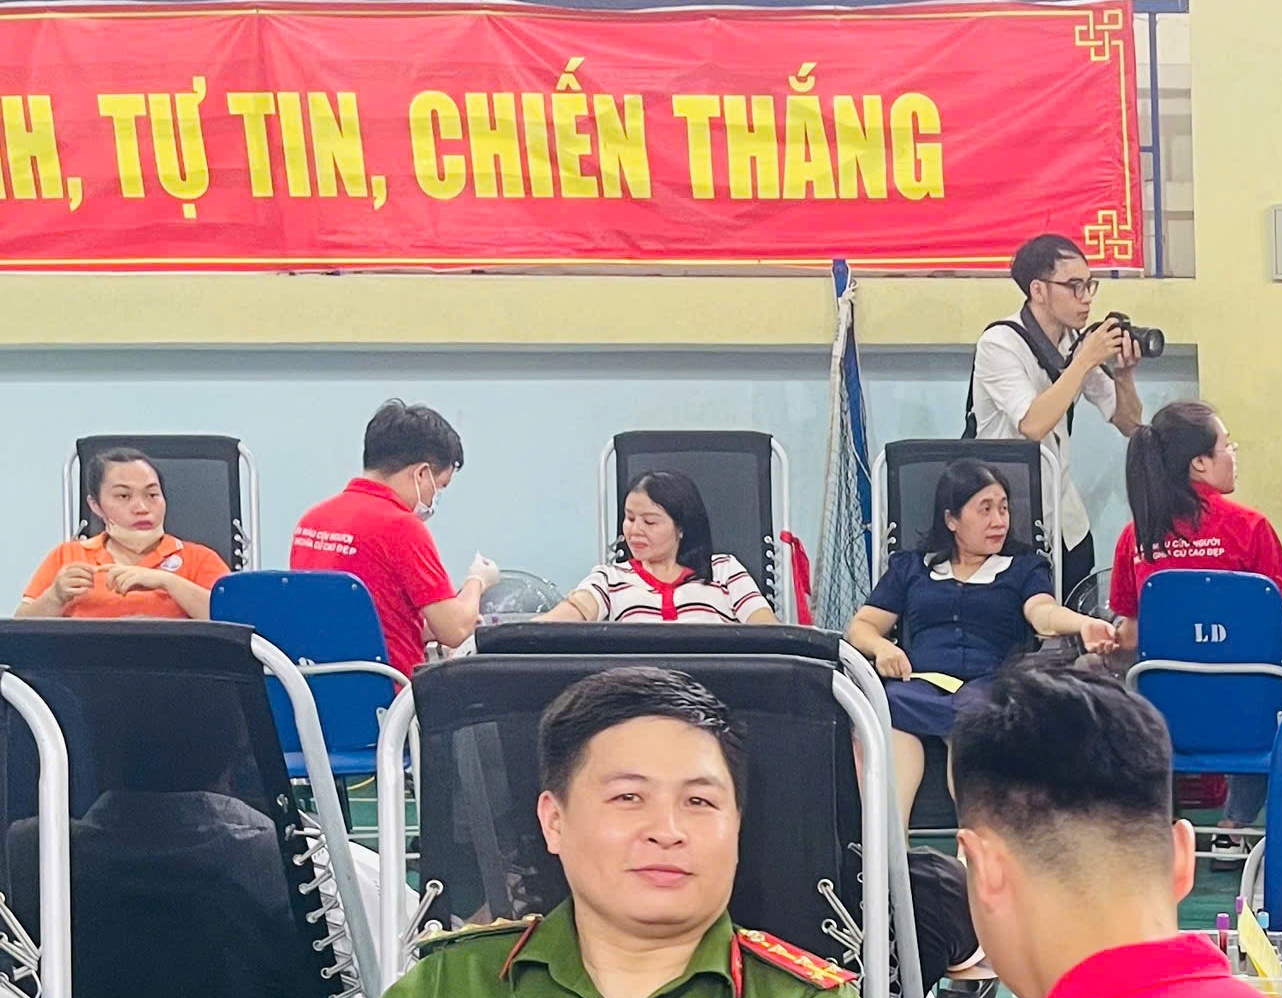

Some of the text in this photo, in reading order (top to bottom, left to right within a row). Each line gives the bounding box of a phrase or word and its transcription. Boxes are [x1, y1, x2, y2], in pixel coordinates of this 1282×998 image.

[0, 56, 945, 219] H, TỰ TIN, CHIẾN THẮNG
